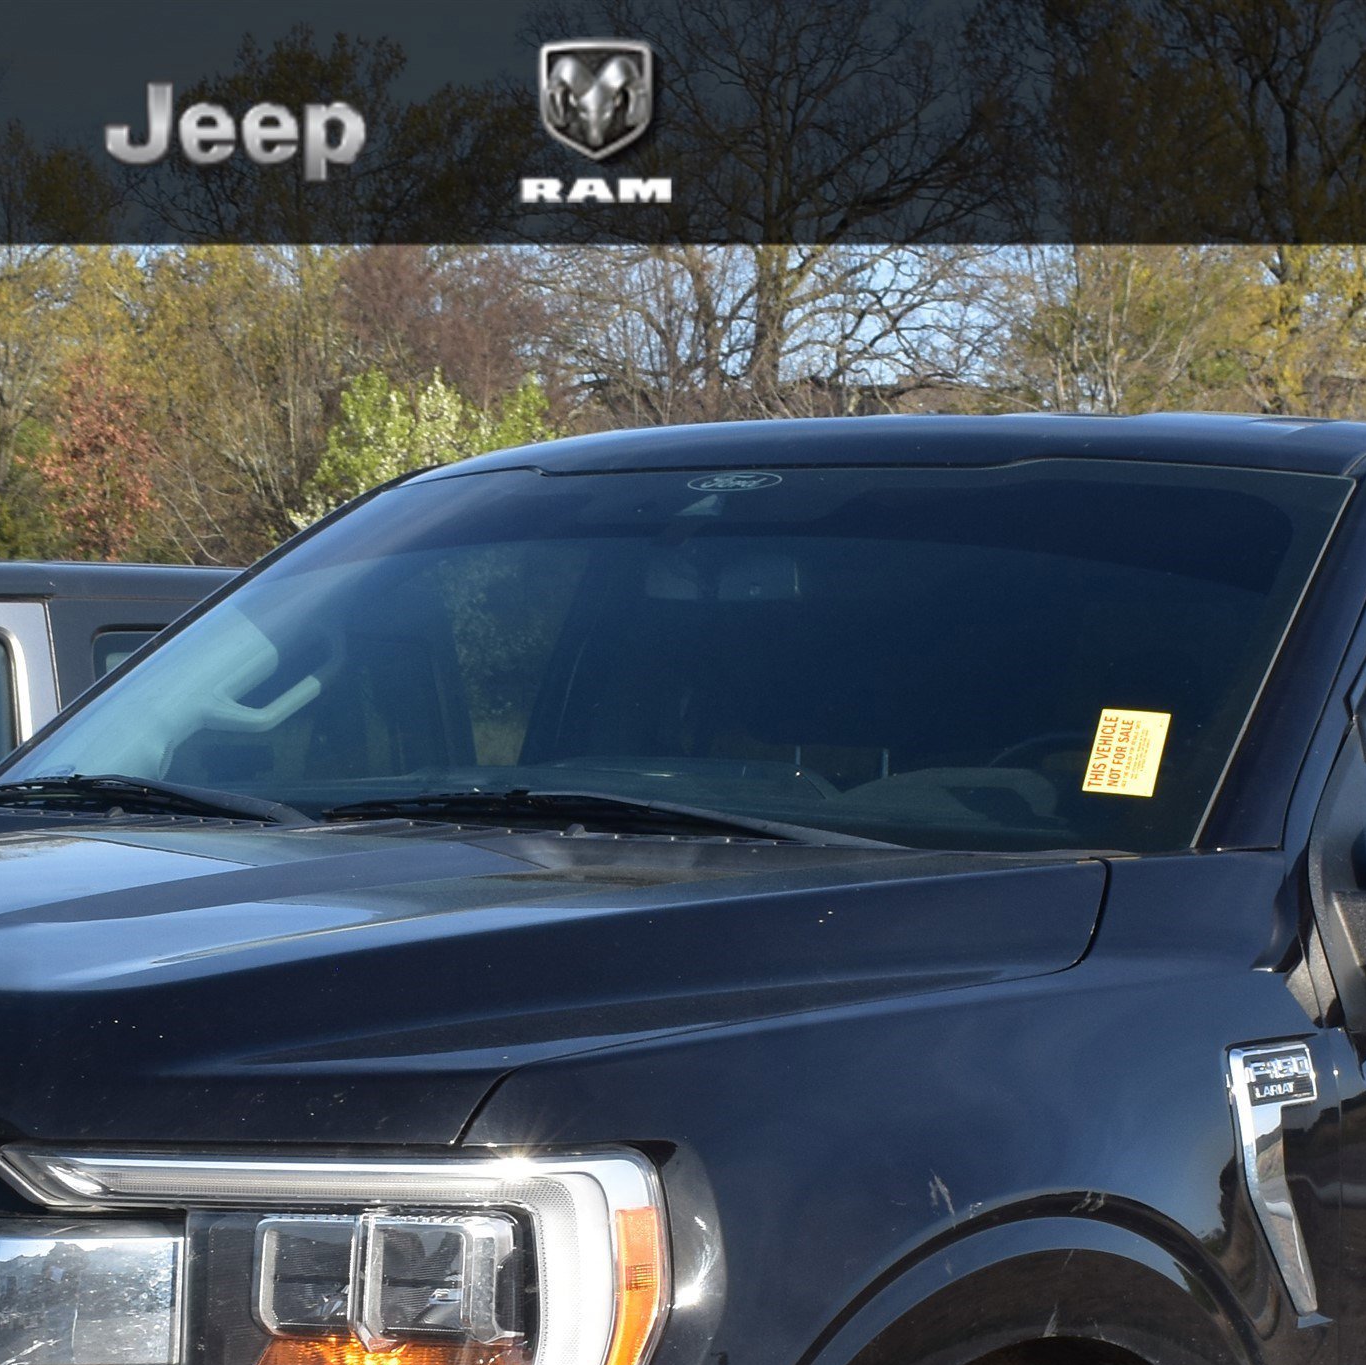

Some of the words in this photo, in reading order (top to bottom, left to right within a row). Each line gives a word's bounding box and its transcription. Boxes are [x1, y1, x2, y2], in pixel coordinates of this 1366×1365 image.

[701, 474, 768, 489] Ford
[1095, 716, 1119, 759] VEHICLE
[1118, 720, 1134, 742] SALE
[1112, 746, 1127, 765] FOR
[1087, 763, 1107, 787] THIS
[1107, 768, 1122, 787] NOT
[1255, 1081, 1295, 1098] LARIAT
